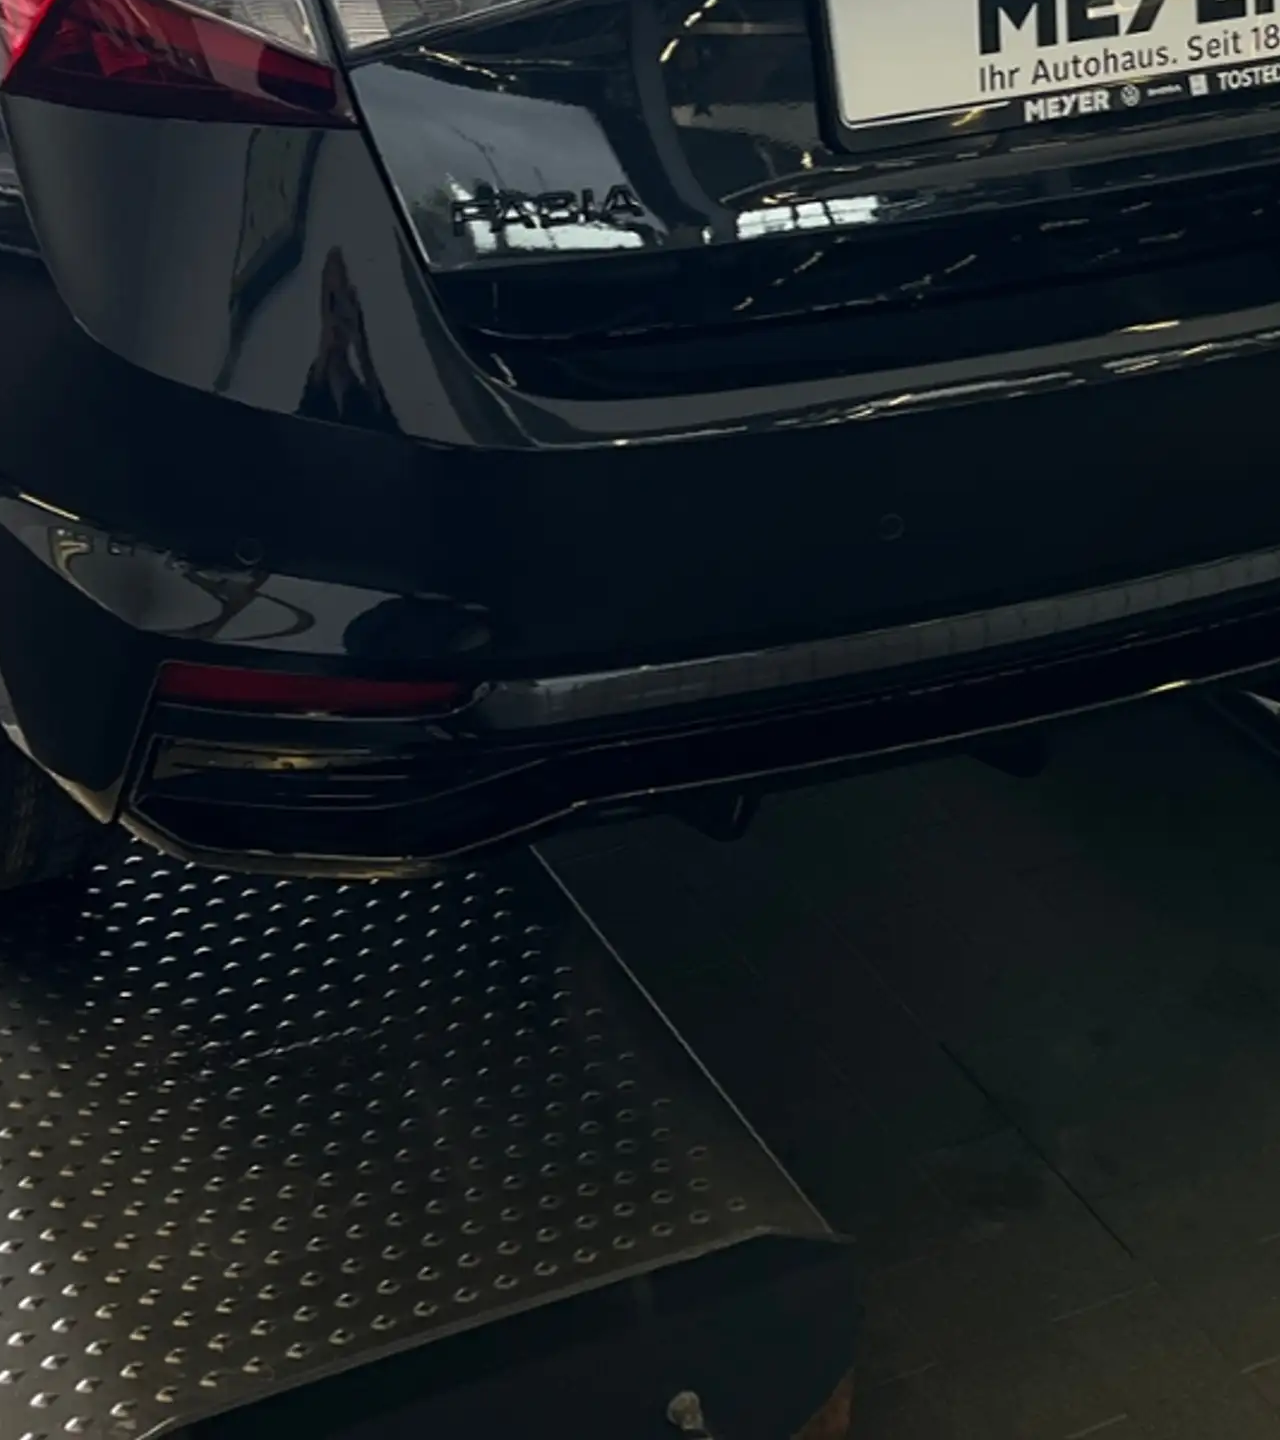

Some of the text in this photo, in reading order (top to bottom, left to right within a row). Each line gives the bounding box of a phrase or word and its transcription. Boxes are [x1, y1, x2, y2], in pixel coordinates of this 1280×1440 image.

[979, 64, 1020, 93] Ihr
[1031, 47, 1178, 86] Autohaus.
[1186, 29, 1243, 63] Seit
[1023, 88, 1111, 123] MEYER
